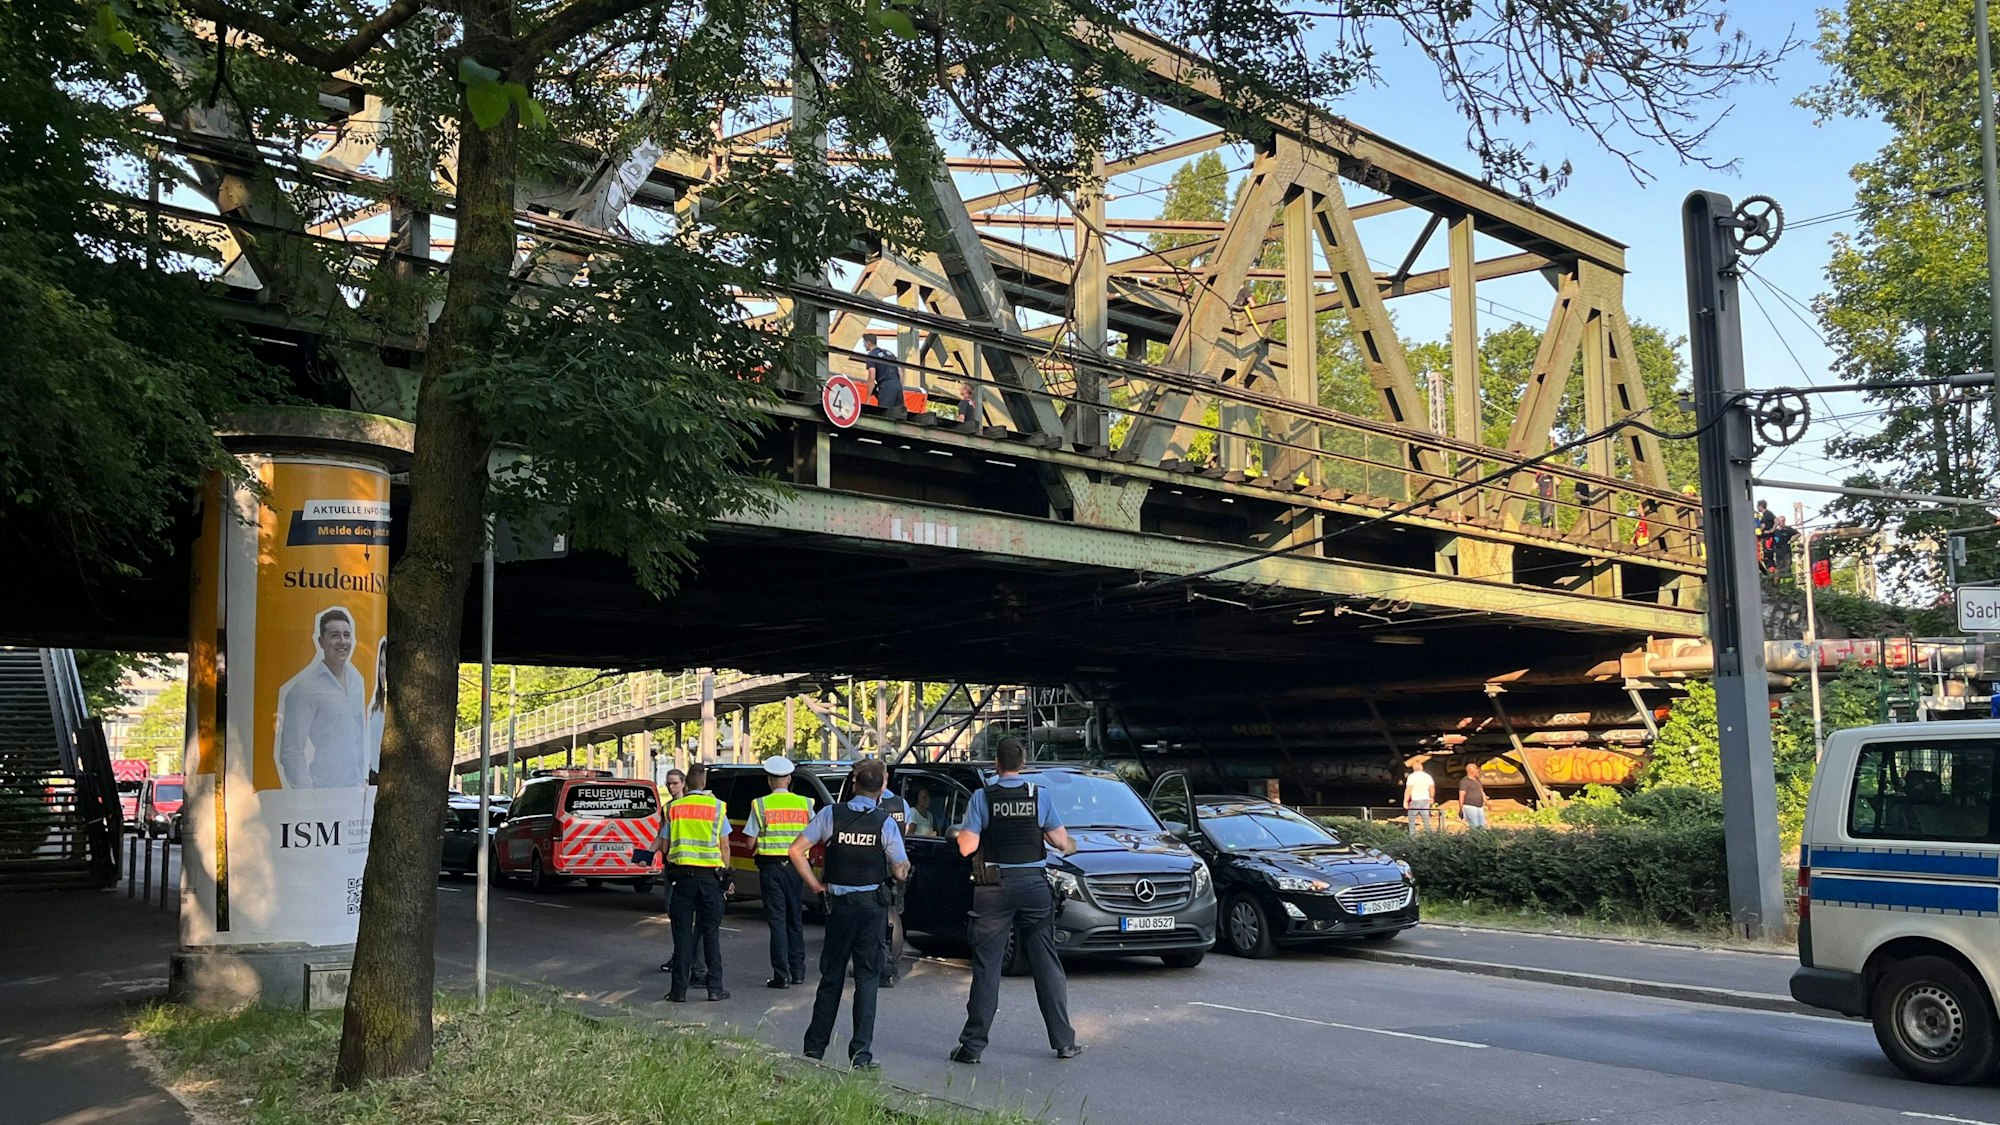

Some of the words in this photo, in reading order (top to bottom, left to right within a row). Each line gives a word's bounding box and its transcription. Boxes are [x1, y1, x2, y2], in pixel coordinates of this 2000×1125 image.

[313, 505, 361, 514] AKTUELLE
[317, 525, 352, 536] Melde
[354, 525, 372, 536] dich
[578, 788, 645, 799] FEUERWEHR
[993, 801, 1036, 817] POLIZEI
[279, 821, 341, 849] ISM
[838, 831, 877, 846] POLIZEI
[1139, 918, 1151, 928] UO
[1152, 917, 1173, 928] 8527
